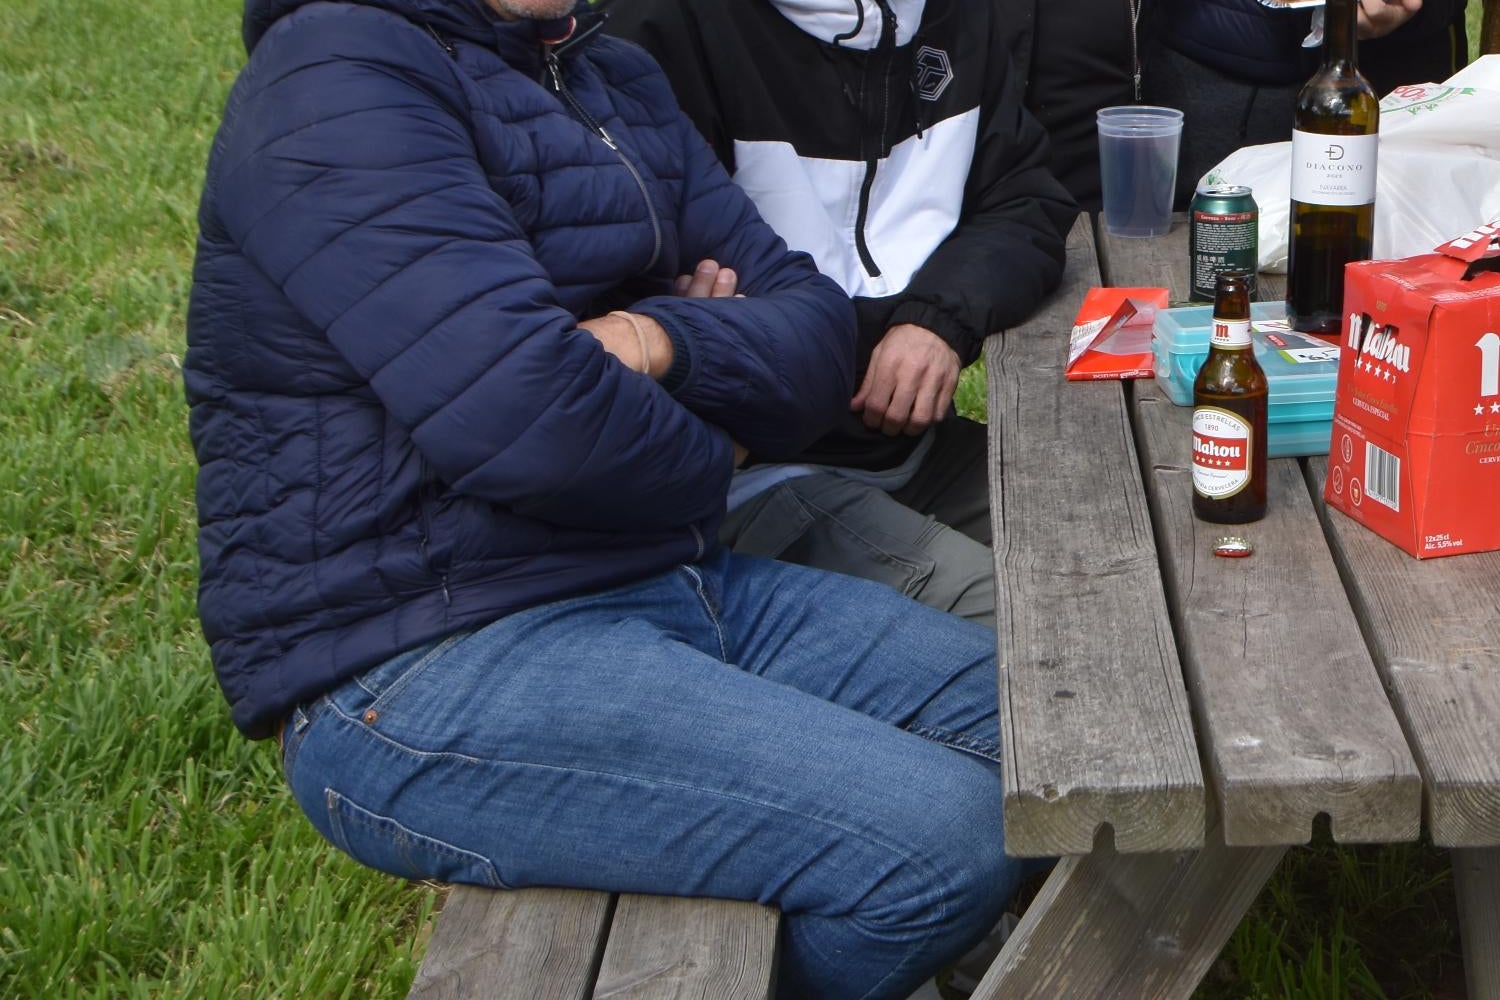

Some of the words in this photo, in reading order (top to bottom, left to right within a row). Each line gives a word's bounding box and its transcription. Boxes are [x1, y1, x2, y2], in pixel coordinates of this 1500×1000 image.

[1306, 162, 1363, 171] DIACONO
[1205, 413, 1241, 432] ESTRELLAS
[1193, 435, 1241, 458] Mahou
[1465, 438, 1500, 455] Cinco
